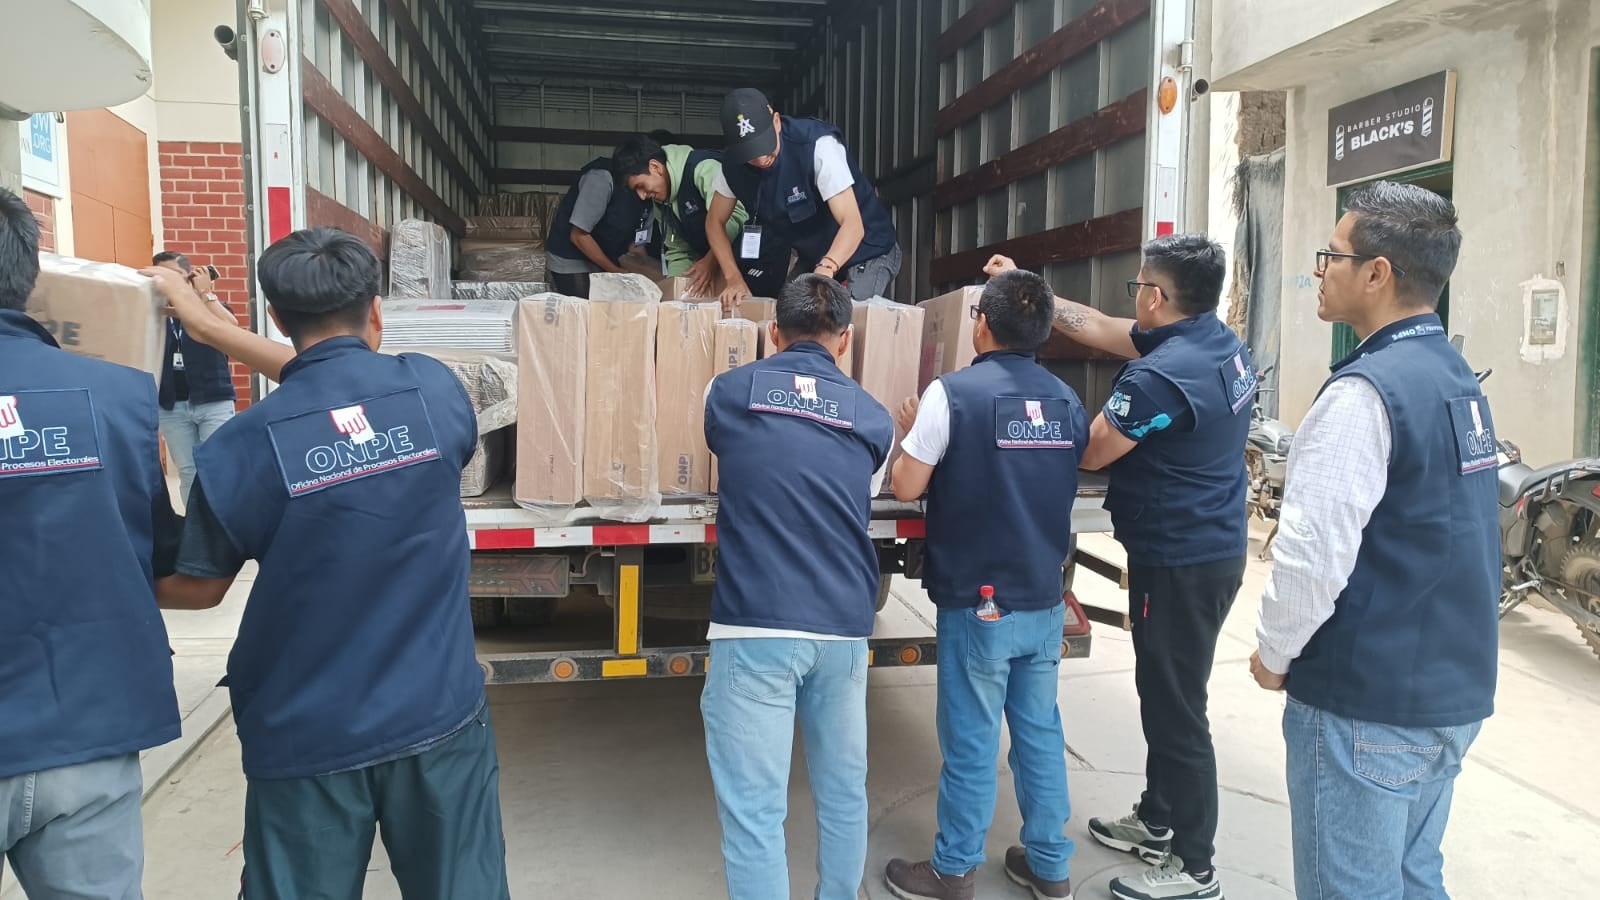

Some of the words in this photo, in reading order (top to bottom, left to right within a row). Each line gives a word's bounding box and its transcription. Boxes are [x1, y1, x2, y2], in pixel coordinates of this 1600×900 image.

[1347, 116, 1381, 132] BARBER
[1385, 104, 1421, 121] STUDIO
[1350, 120, 1414, 150] BLACK'S
[767, 389, 839, 418] ONPE
[1007, 420, 1062, 439] ONPE
[1466, 428, 1493, 456] ONPE
[2, 461, 46, 470] Procesos
[47, 456, 99, 466] Electorales
[305, 425, 414, 474] ONPE
[291, 478, 320, 491] Oficina
[319, 468, 351, 483] Nacional
[353, 465, 363, 475] de
[363, 458, 397, 471] Procesos
[397, 447, 438, 463] Electorales
